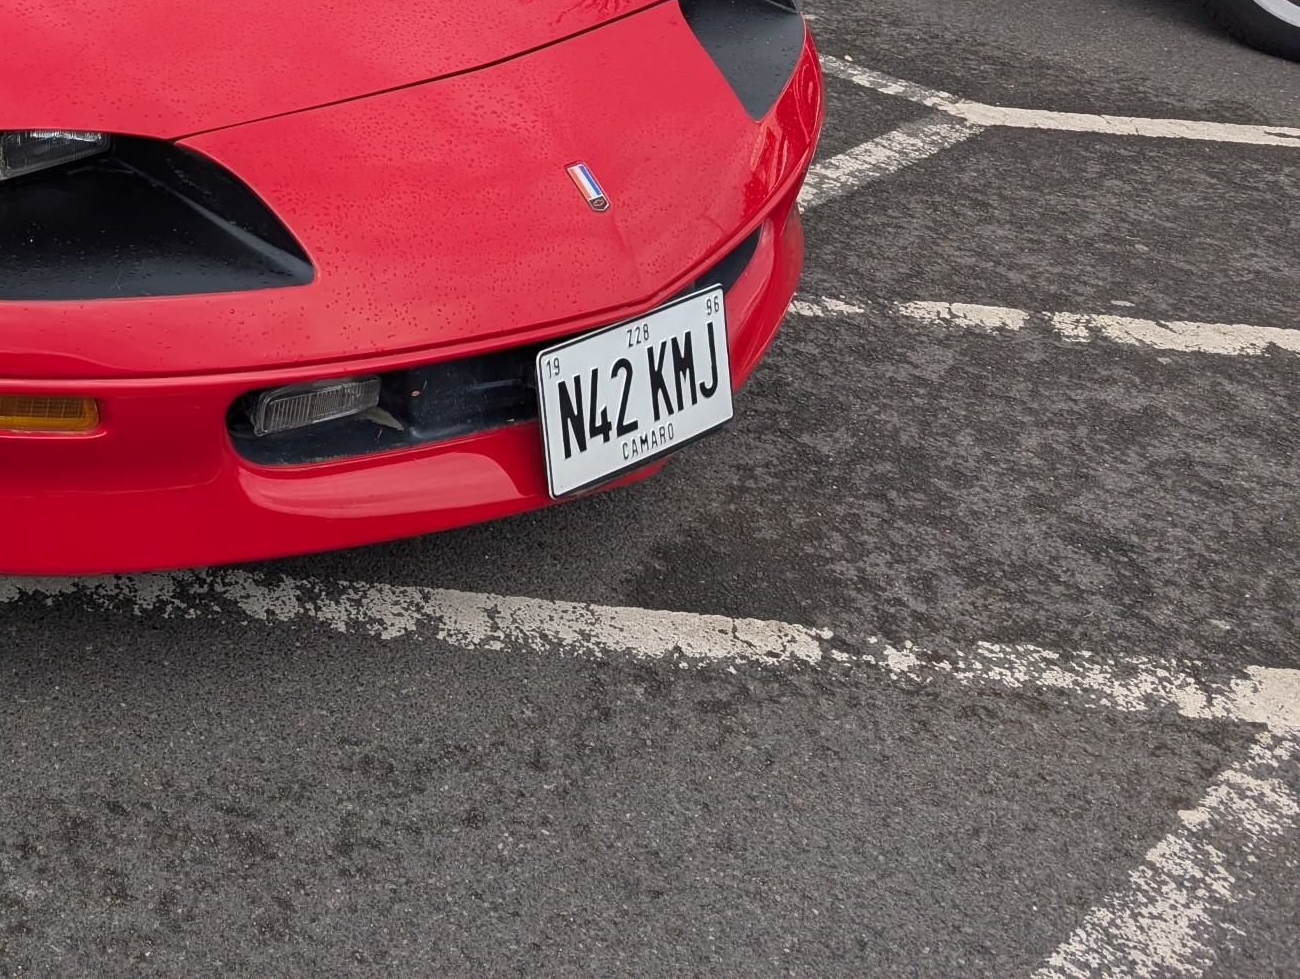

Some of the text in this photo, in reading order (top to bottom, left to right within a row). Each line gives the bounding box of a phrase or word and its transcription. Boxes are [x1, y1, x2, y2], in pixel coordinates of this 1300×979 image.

[545, 295, 720, 379] 19 Z28 96
[557, 321, 719, 460] N42 KMJ
[622, 422, 675, 461] CAMARO
